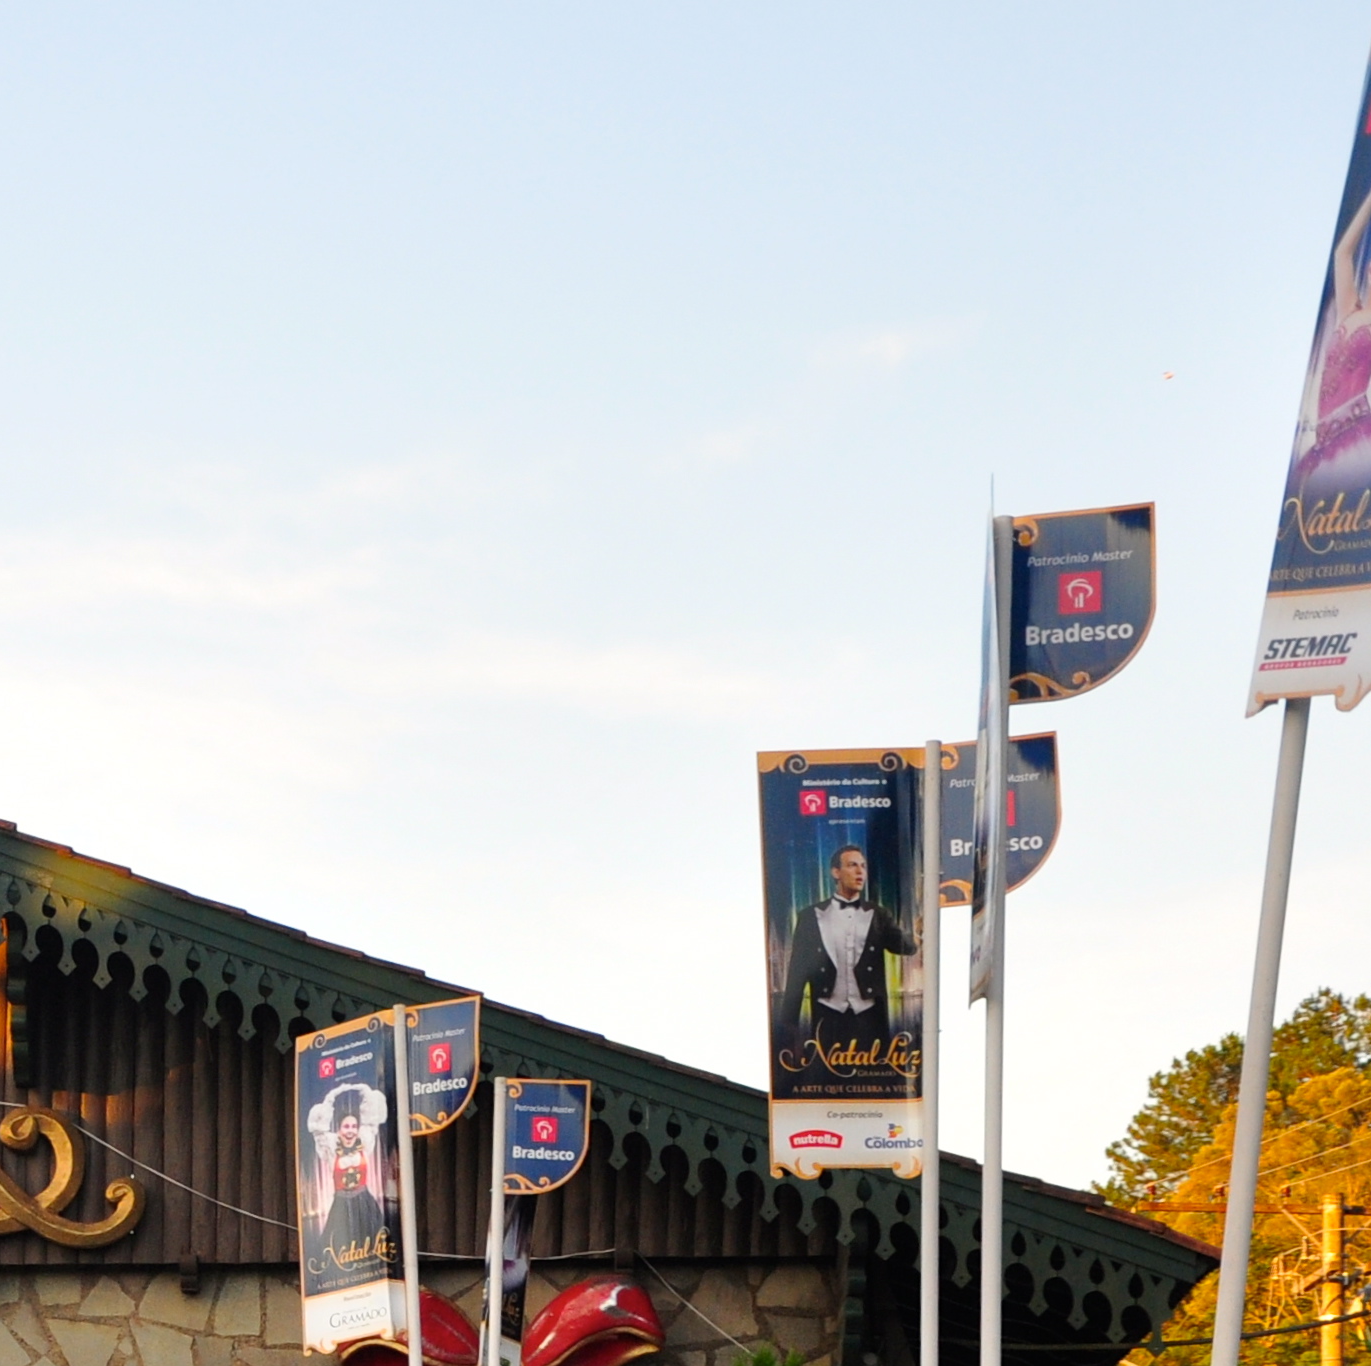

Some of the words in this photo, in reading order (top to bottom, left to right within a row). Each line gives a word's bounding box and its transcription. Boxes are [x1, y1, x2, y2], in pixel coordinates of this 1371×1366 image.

[1276, 478, 1371, 554] Natal
[1091, 550, 1133, 562] Master
[1293, 566, 1315, 581] QUE
[1316, 564, 1356, 578] CELEBRA
[1025, 622, 1134, 646] Bradesco
[1264, 632, 1358, 661] STEMAC
[828, 795, 892, 809] Bradesco
[779, 1017, 882, 1078] Natal
[878, 1031, 922, 1078] Luz
[336, 1052, 374, 1070] Bradesco
[412, 1076, 468, 1096] Bradesco
[792, 1085, 799, 1093] A
[801, 1084, 823, 1093] ARTE
[825, 1084, 844, 1094] QUE
[845, 1084, 884, 1093] CELEBRA
[885, 1085, 891, 1093] A
[892, 1084, 917, 1093] VIDA
[793, 1134, 839, 1146] nutrella
[511, 1145, 576, 1161] Bradesco
[307, 1231, 371, 1275] Natal
[329, 1307, 388, 1328] GRAMADO
